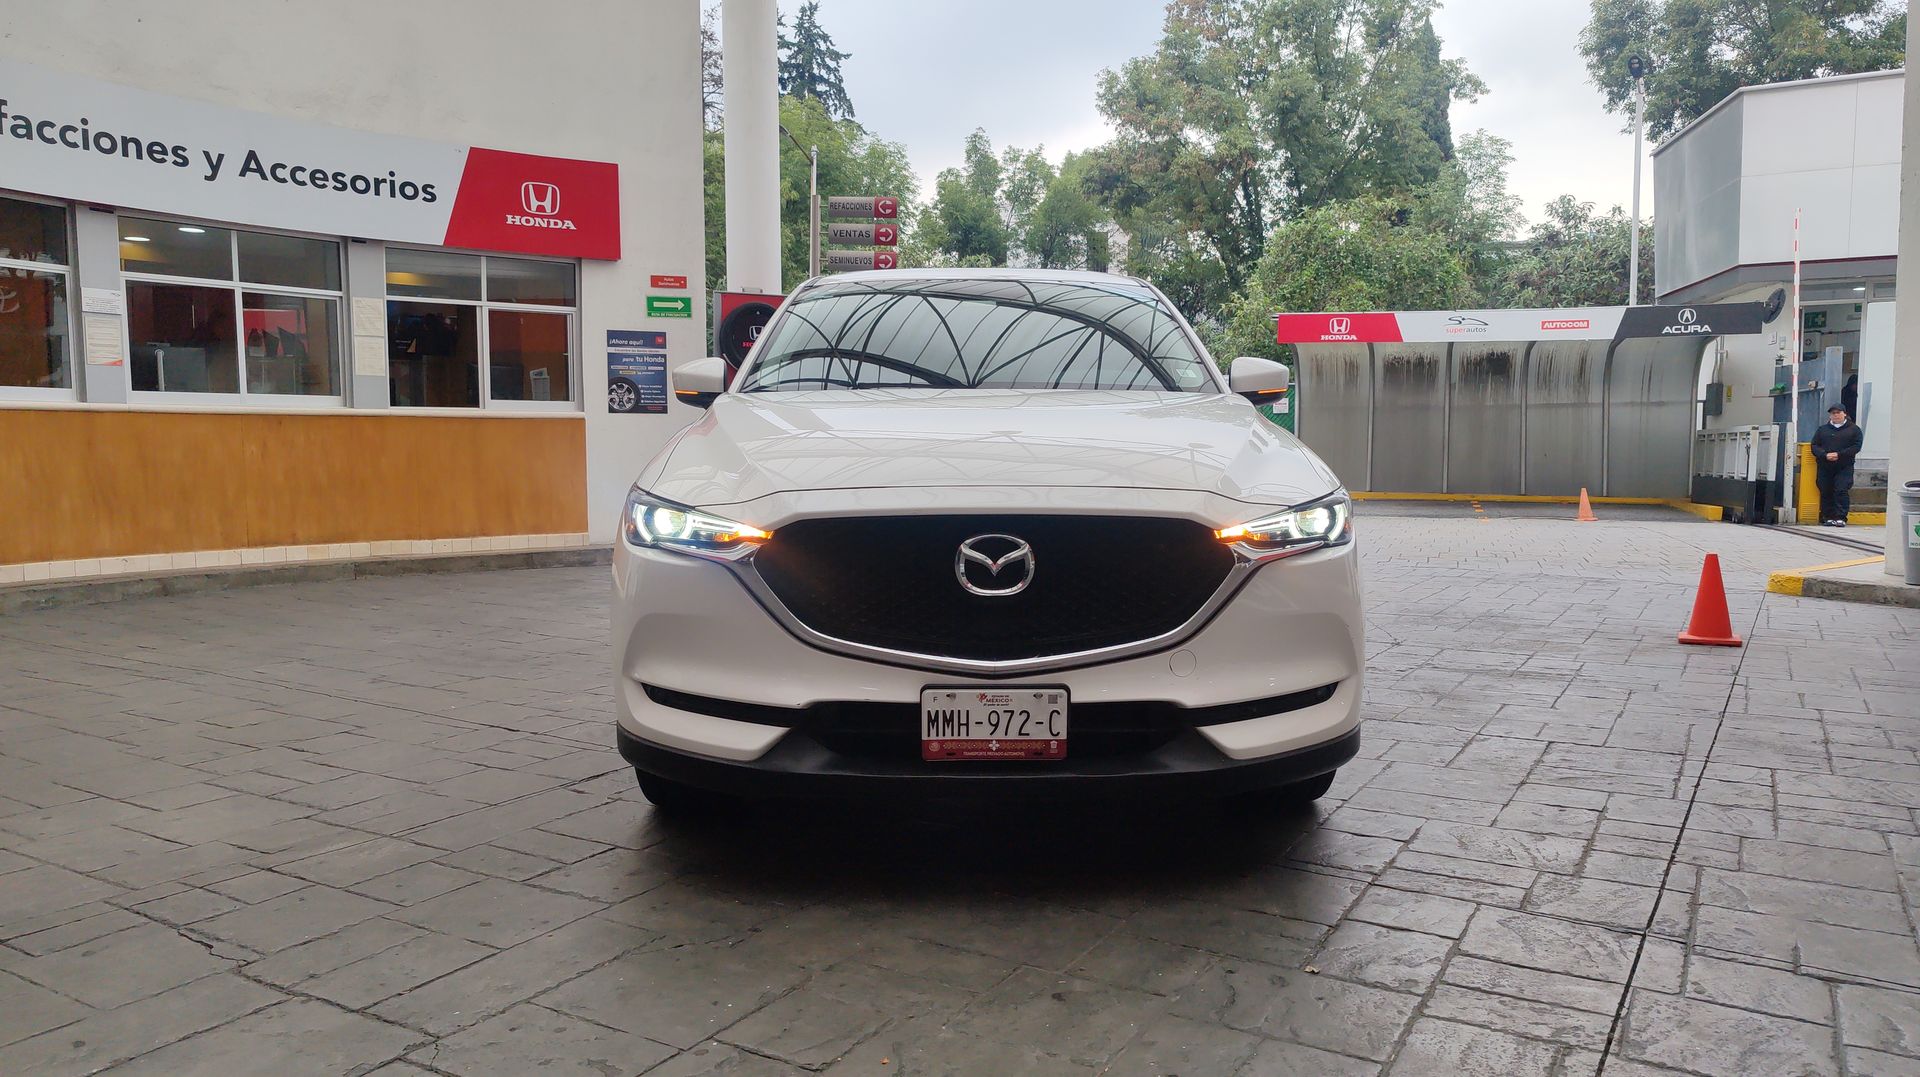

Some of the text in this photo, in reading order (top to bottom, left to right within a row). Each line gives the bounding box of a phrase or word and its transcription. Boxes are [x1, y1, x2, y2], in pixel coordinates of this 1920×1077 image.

[0, 98, 437, 204] facciones y Accesorios
[829, 202, 873, 211] REFACCIONES
[505, 214, 577, 231] HONDA
[832, 229, 871, 238] VENTAS
[829, 256, 873, 265] SEMINUEVOS
[1542, 321, 1588, 329] AUTOCOM
[1661, 324, 1712, 334] ACURA
[1445, 326, 1487, 334] superautos
[644, 355, 665, 363] Honda
[926, 709, 1061, 738] MMH-972-C
